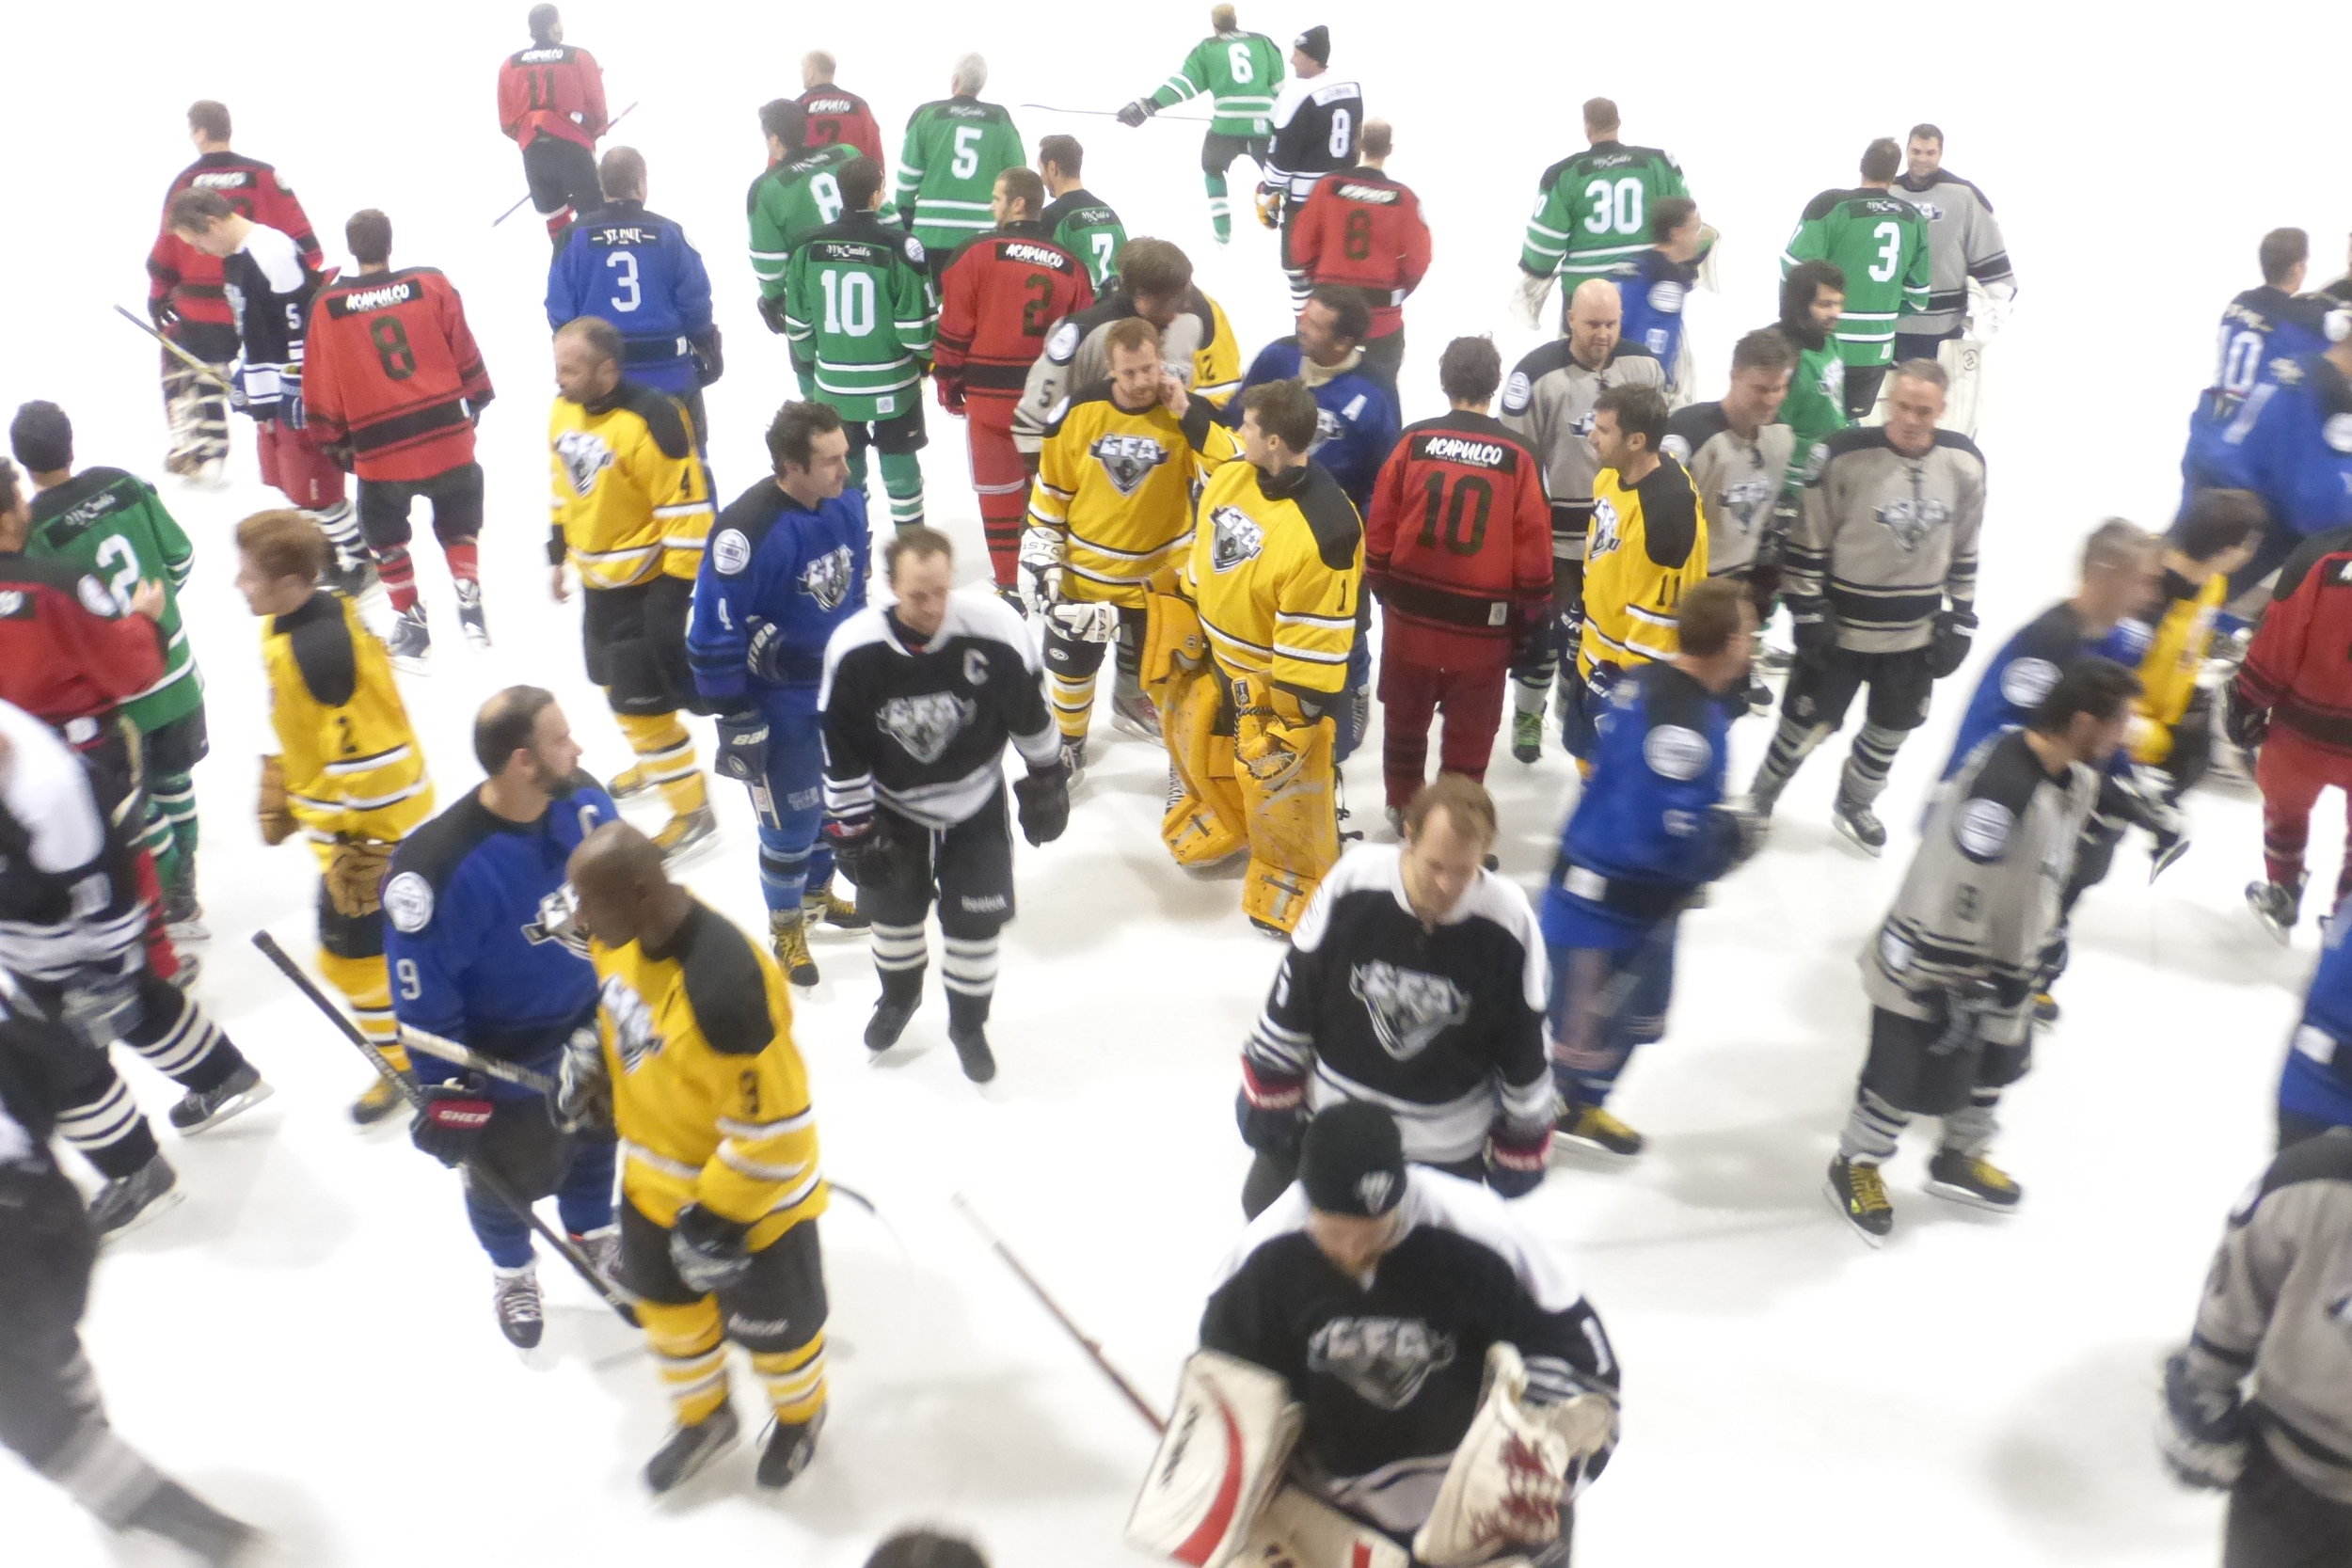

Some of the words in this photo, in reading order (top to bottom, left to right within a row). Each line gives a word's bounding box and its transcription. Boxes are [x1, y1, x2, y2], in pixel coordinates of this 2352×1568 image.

[1228, 42, 1253, 83] 6
[527, 69, 556, 110] 11
[951, 125, 982, 180] 5
[1328, 108, 1351, 158] 8
[1584, 177, 1644, 235] 30
[1005, 243, 1063, 269] ACAPULCO
[1091, 233, 1114, 283] 7
[1867, 221, 1900, 282] 3
[345, 285, 410, 313] ACAPULCO
[607, 251, 641, 311] 3
[820, 270, 874, 337] 10
[1024, 273, 1054, 337] 2
[285, 303, 302, 329] 5
[370, 313, 416, 381] 8
[1425, 436, 1502, 465] ACAPULCO
[1415, 470, 1493, 557] 10
[96, 534, 139, 618] 2
[1337, 578, 1346, 611] 1
[963, 648, 990, 686] C
[396, 958, 421, 1000] 9
[1581, 1315, 1611, 1376] 1
